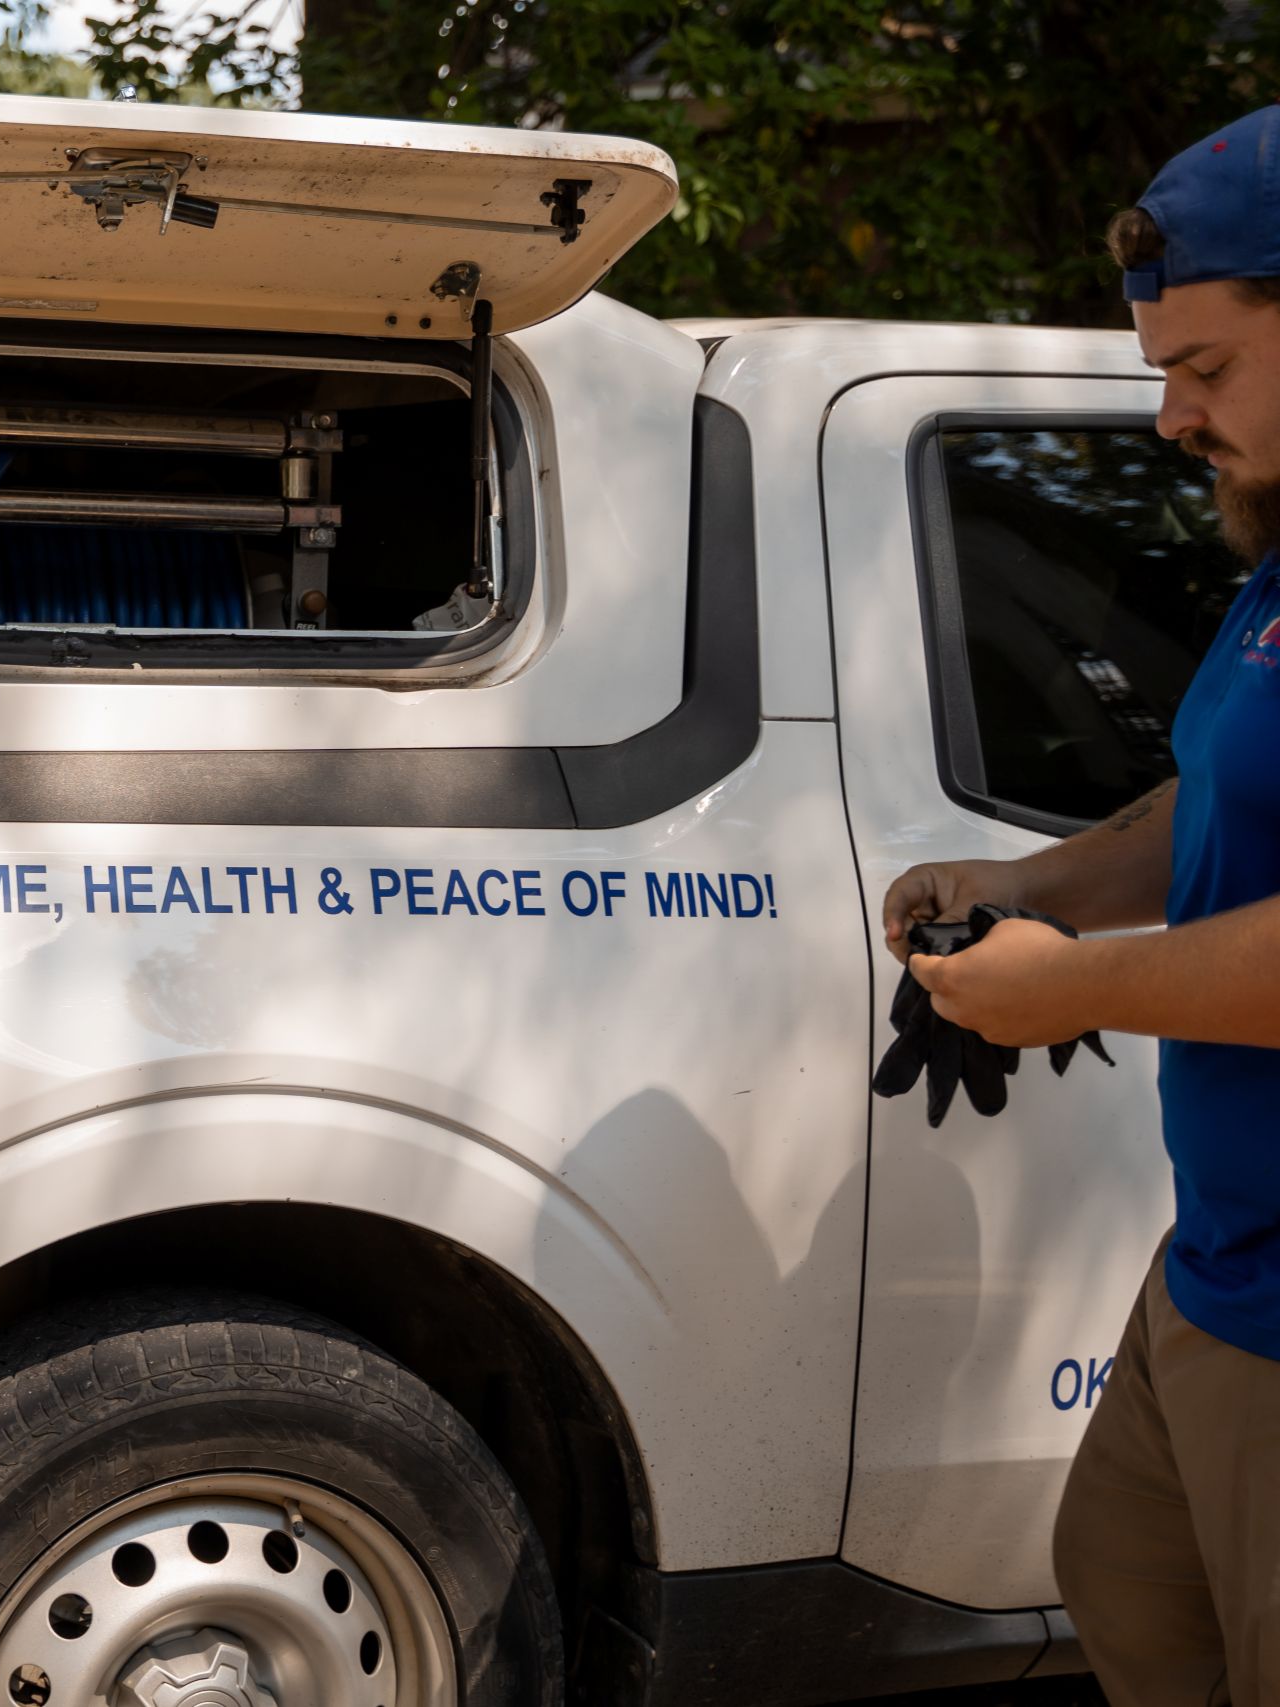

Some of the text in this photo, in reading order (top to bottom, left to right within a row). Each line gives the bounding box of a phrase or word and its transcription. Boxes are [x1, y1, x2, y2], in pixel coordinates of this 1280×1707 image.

[83, 865, 298, 914] HEALTH
[318, 866, 354, 916] &
[370, 867, 546, 917] PEACE
[561, 869, 626, 918] OF
[644, 870, 778, 919] MIND!
